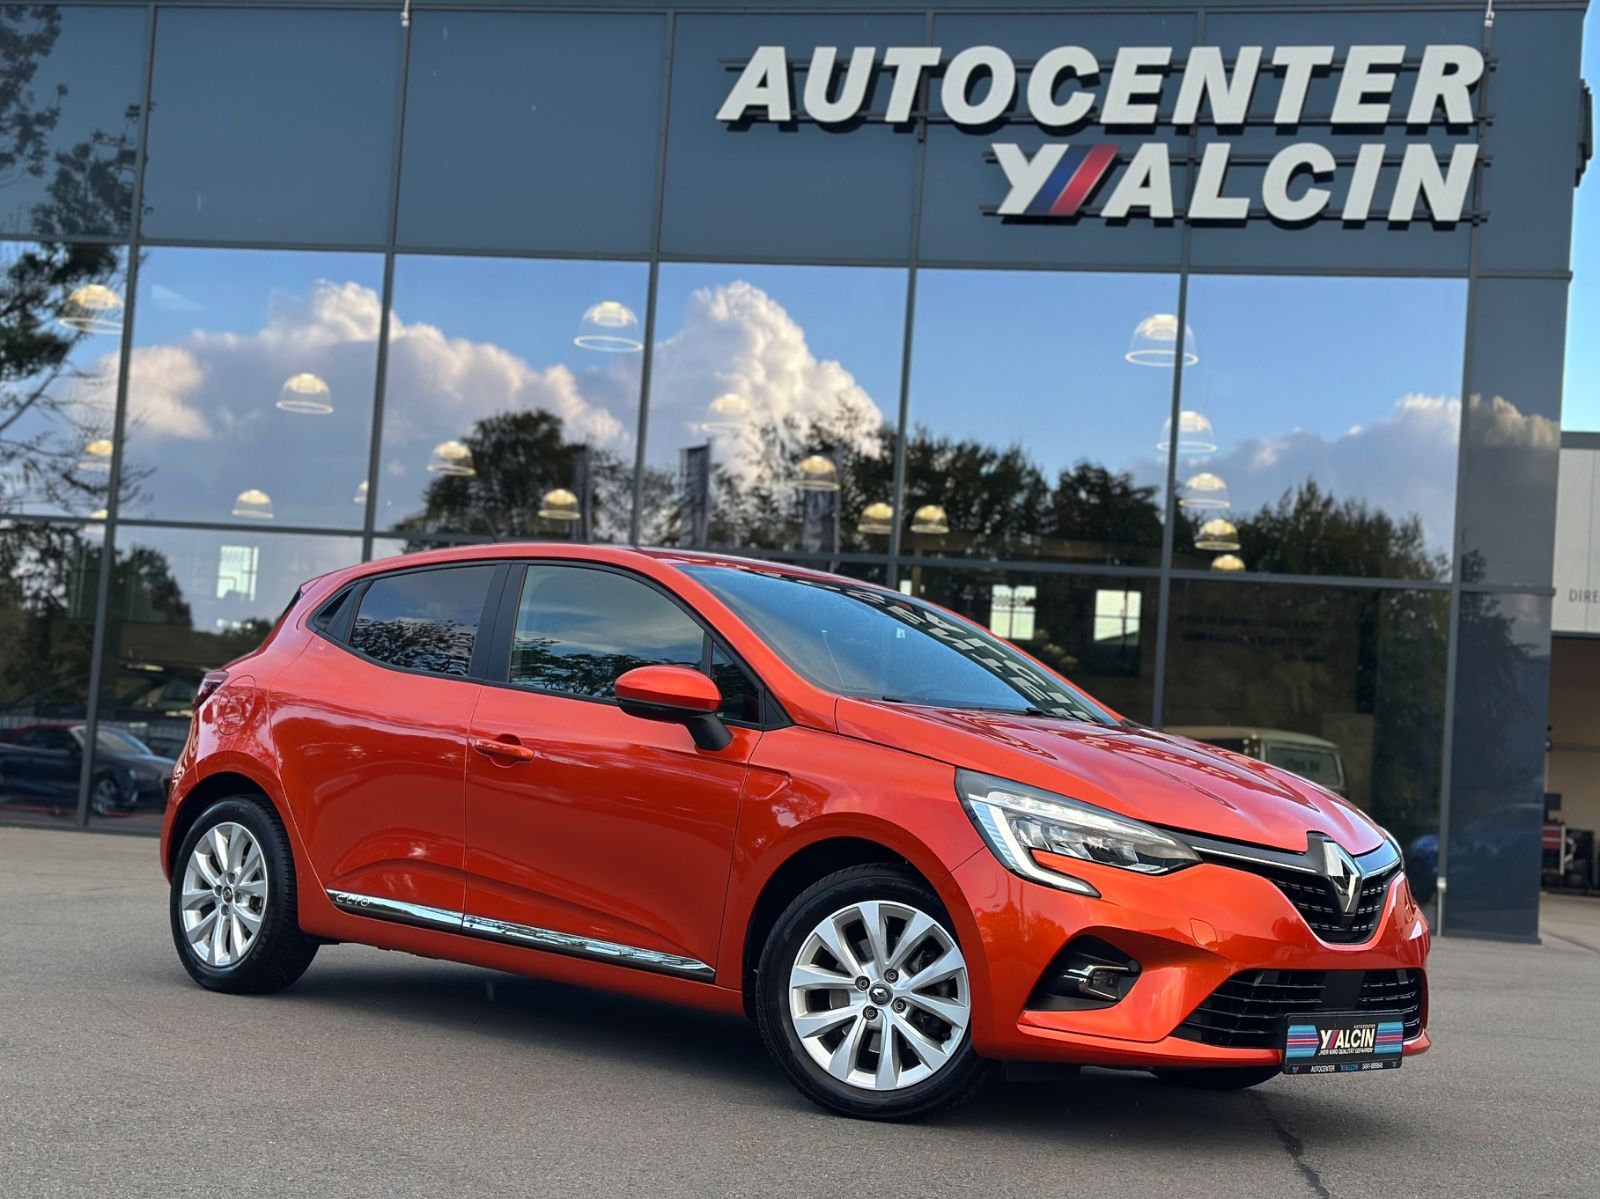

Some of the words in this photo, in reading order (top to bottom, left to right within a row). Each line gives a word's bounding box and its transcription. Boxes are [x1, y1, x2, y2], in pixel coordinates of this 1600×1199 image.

[715, 45, 1485, 125] AUTOCENTER
[991, 142, 1479, 222] YALCIN
[336, 893, 369, 906] CLIO
[1320, 1028, 1376, 1050] YALCIN
